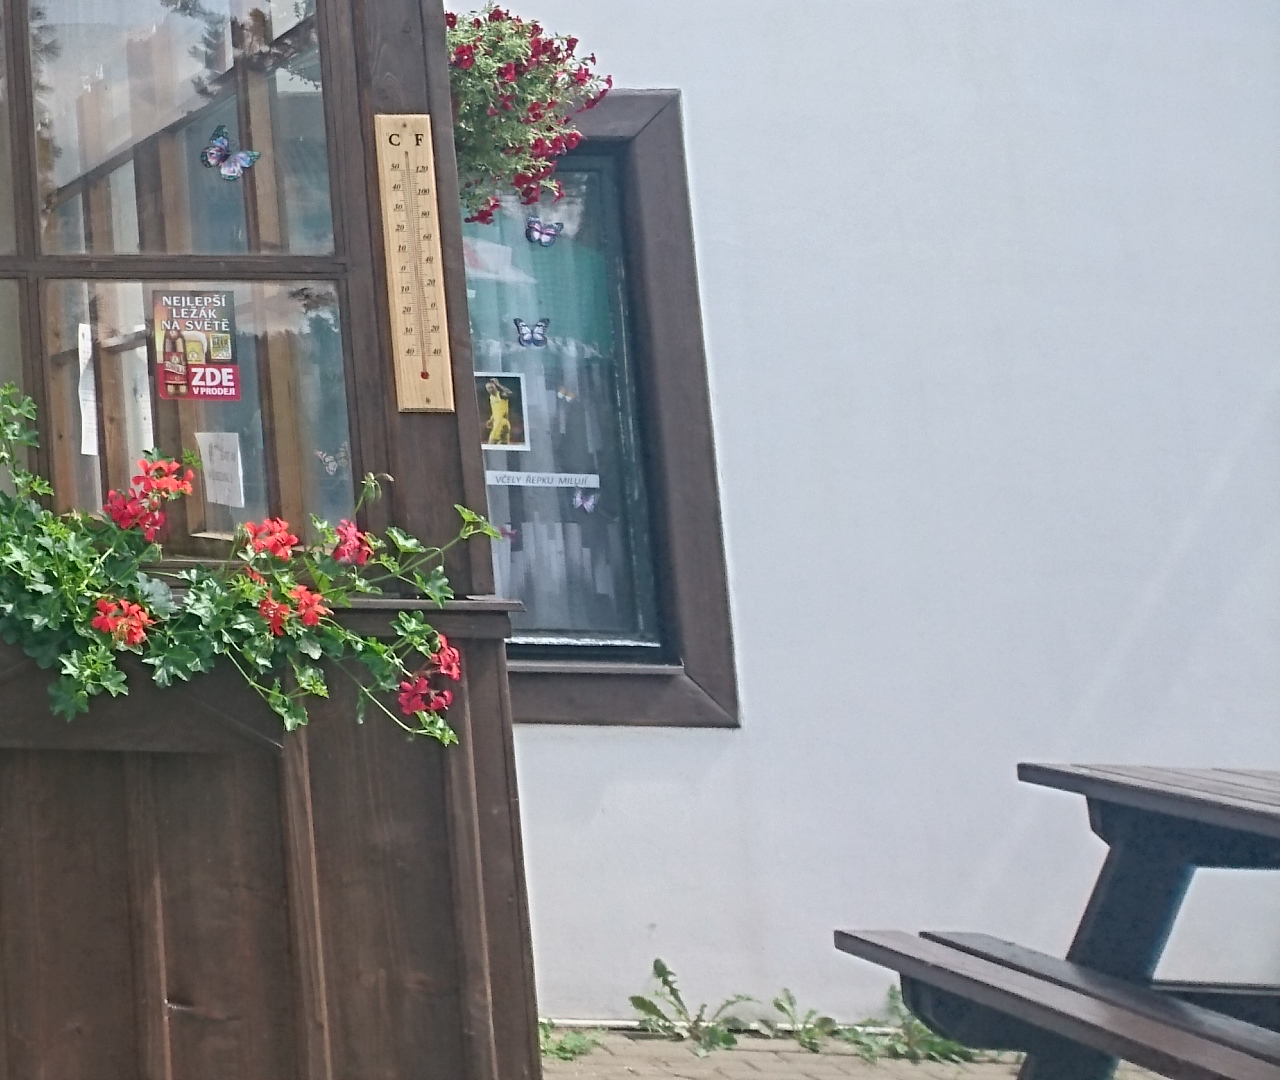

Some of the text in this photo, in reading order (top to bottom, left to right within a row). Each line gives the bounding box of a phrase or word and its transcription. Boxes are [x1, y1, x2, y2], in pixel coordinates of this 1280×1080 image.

[162, 294, 226, 307] NEJLEPŠÍ
[172, 306, 217, 319] LEŽÁK
[161, 318, 230, 331] NA SVĚTĚ
[191, 367, 235, 386] ZDE
[192, 387, 235, 396] V PRODEJI
[495, 475, 588, 485] VČELY ŘEPKU MILUJÍ
